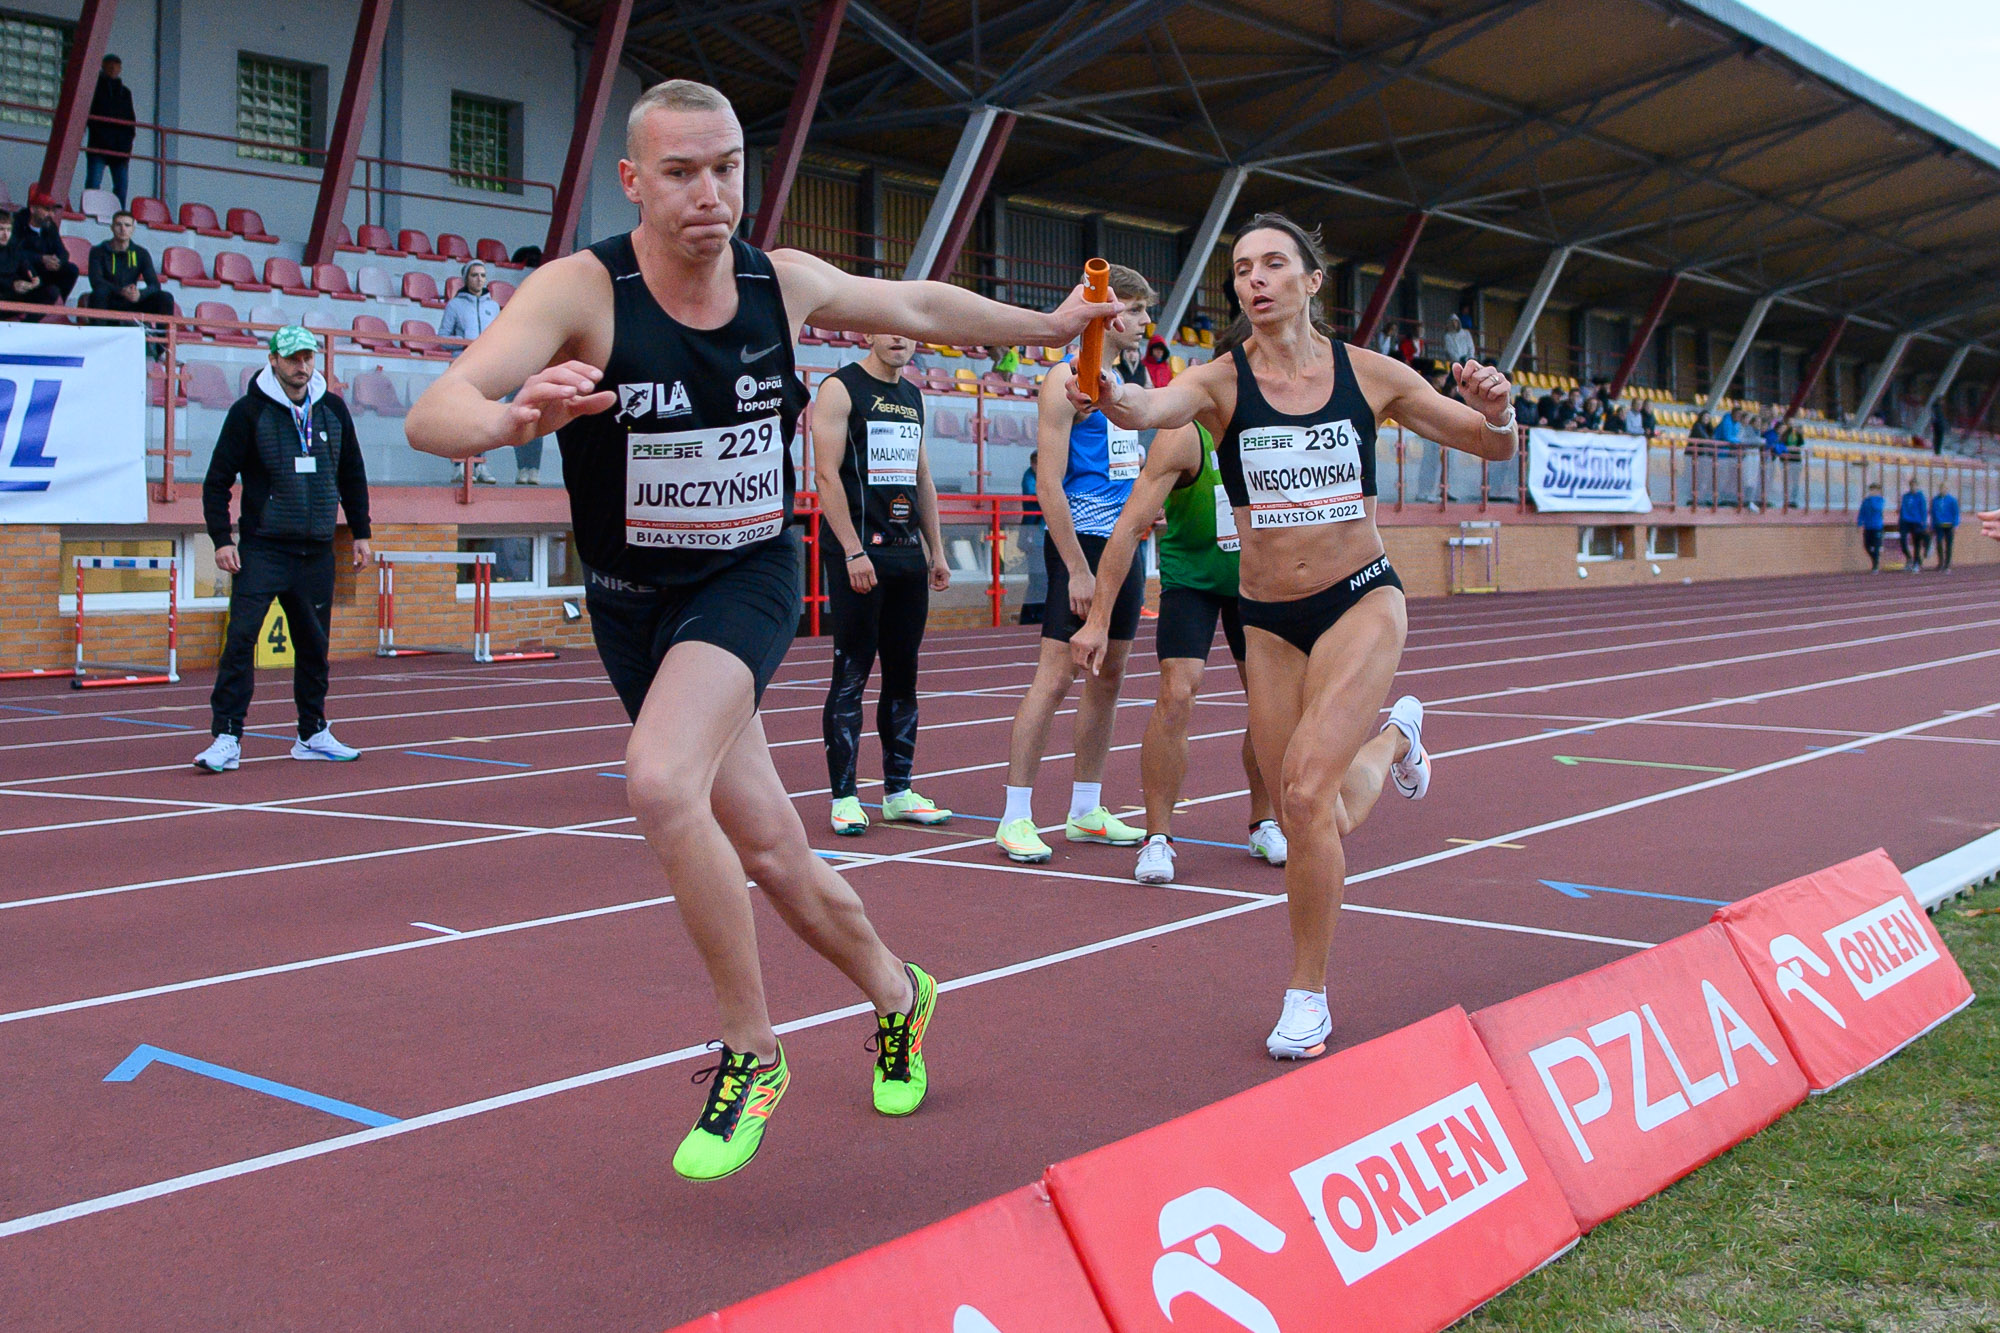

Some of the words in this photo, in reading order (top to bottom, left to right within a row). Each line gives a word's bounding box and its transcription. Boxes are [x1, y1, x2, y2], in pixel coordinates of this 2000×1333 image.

[758, 379, 783, 390] OPOLE
[878, 403, 919, 417] BEFASTER
[717, 423, 773, 460] 229
[899, 425, 919, 439] 214
[1305, 425, 1349, 451] 236
[634, 468, 779, 508] JURCZYŃSKI
[1248, 462, 1356, 491] WESOŁOWSKA
[1257, 509, 1326, 525] BIAŁYSTOK
[1329, 504, 1358, 518] 2022
[636, 531, 732, 546] BIAŁYSTOK
[737, 524, 775, 543] 2022
[592, 571, 656, 593] NIKE
[1350, 561, 1381, 591] NIKE
[268, 616, 287, 653] 4
[1839, 909, 1928, 984] ORLEN
[1528, 979, 1778, 1164] PZLA
[1322, 1104, 1508, 1253] ORLEN
